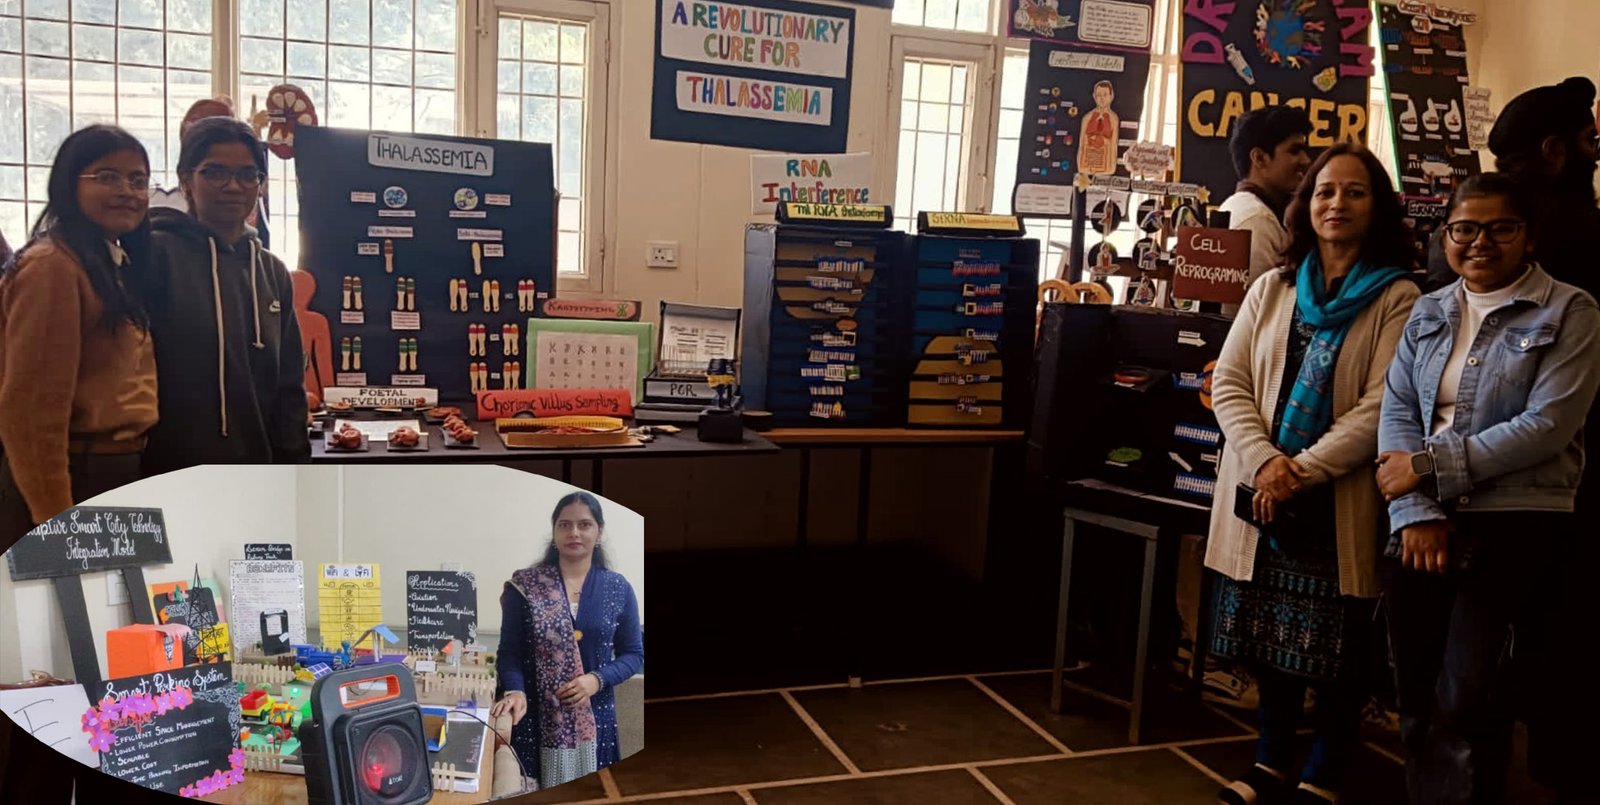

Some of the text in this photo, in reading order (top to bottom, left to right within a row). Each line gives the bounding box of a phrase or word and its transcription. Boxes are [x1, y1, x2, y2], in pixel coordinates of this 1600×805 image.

[672, 2, 844, 44] A REVOLUTIONARY
[703, 33, 800, 67] CURE FOR
[686, 76, 822, 115] THALASSEMIA
[1187, 89, 1367, 147] CAER
[372, 135, 488, 170] THALASSEMIA
[786, 159, 832, 177] RNA
[761, 181, 869, 204] Interference
[1190, 233, 1227, 254] CELL
[1175, 255, 1249, 291] REPROGRAMING
[359, 388, 407, 397] FOETAL
[670, 383, 697, 397] PCR
[342, 397, 426, 407] DEVELOPMEN
[575, 394, 619, 412] Sampling
[70, 510, 103, 534] Smart
[104, 512, 129, 543] City
[66, 536, 110, 569] Integration
[408, 574, 459, 590] Applications
[411, 602, 445, 612] Underwater
[410, 615, 444, 626] Healthcare
[411, 629, 455, 642] Transportation
[192, 667, 228, 690] System
[114, 731, 152, 746] EFFICIENT
[176, 716, 215, 731] MANAGEMENT
[114, 745, 136, 756] LOWER
[138, 738, 158, 750] POWER
[117, 753, 150, 766] SCALABLE
[173, 759, 210, 773] INFORMATION
[117, 761, 157, 777] LOWER COST
